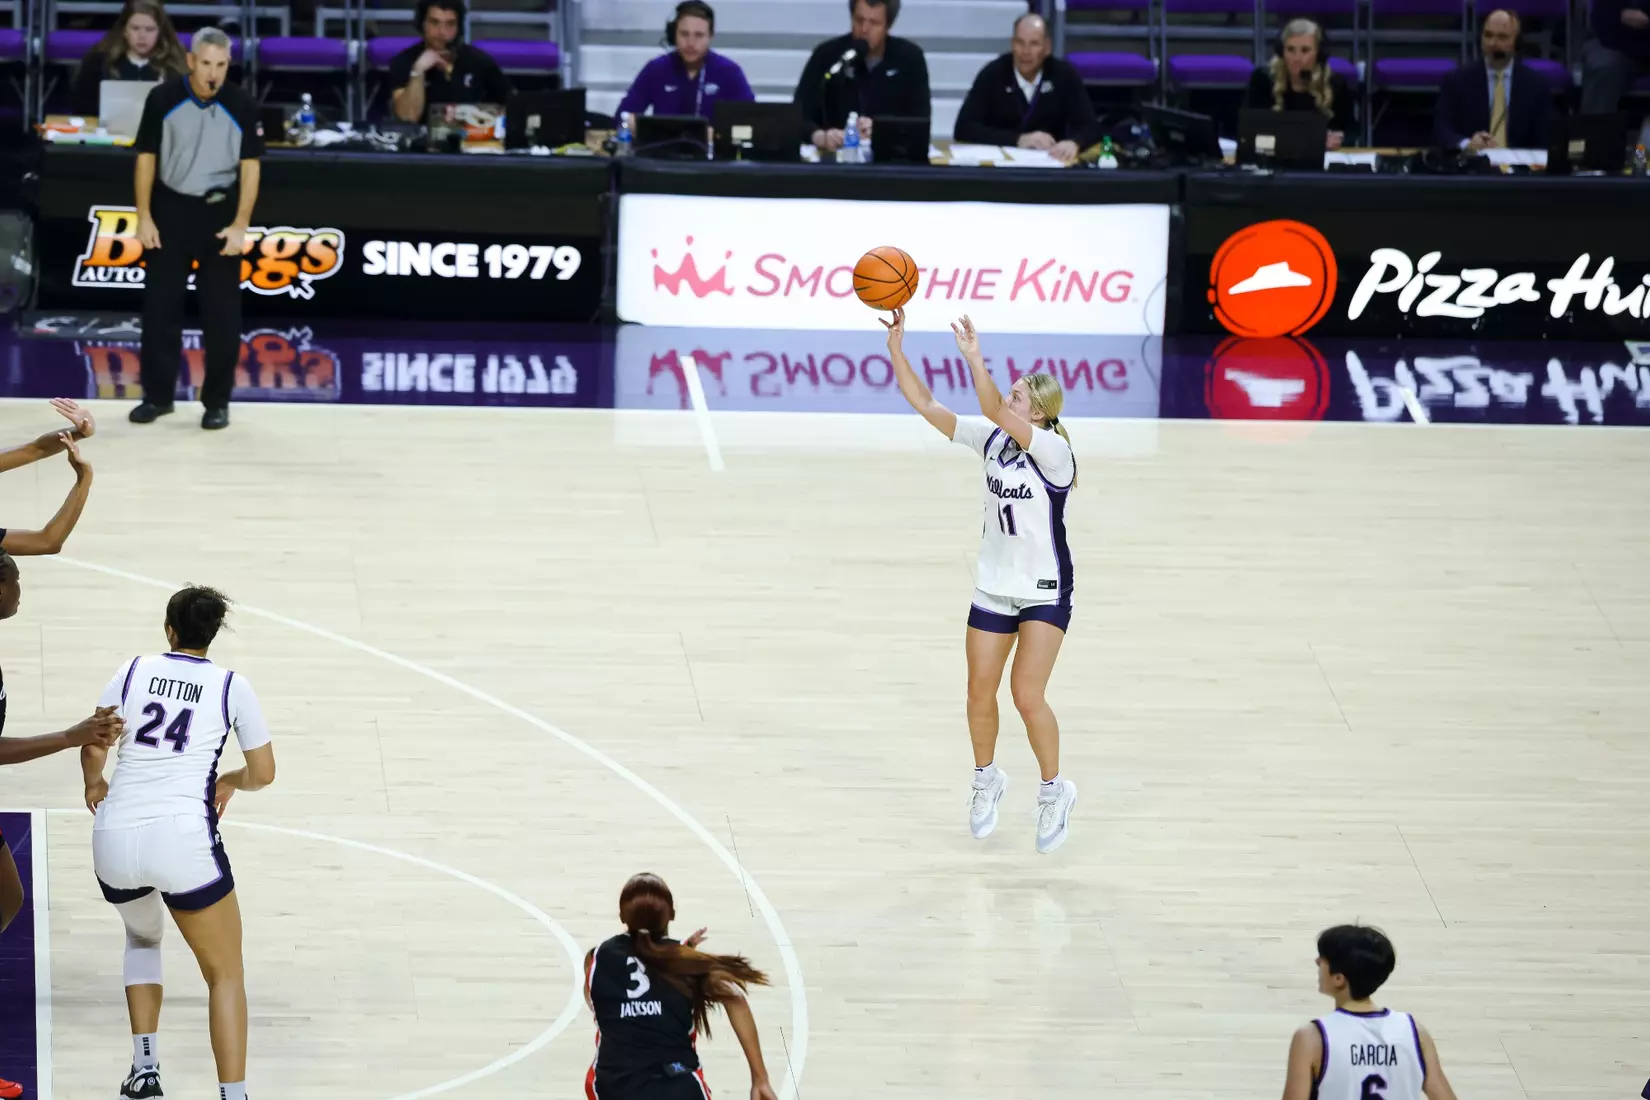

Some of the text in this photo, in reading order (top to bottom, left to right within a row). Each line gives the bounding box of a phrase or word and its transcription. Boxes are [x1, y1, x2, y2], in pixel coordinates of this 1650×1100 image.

[362, 240, 582, 280] SINCE 1979
[746, 253, 1002, 300] SMOHIE
[1348, 247, 1541, 321] Pizza
[148, 676, 203, 704] COTTON
[134, 701, 195, 753] 24
[626, 956, 651, 999] 3
[620, 1000, 662, 1019] JACKSON
[1350, 1043, 1398, 1067] GARCIA
